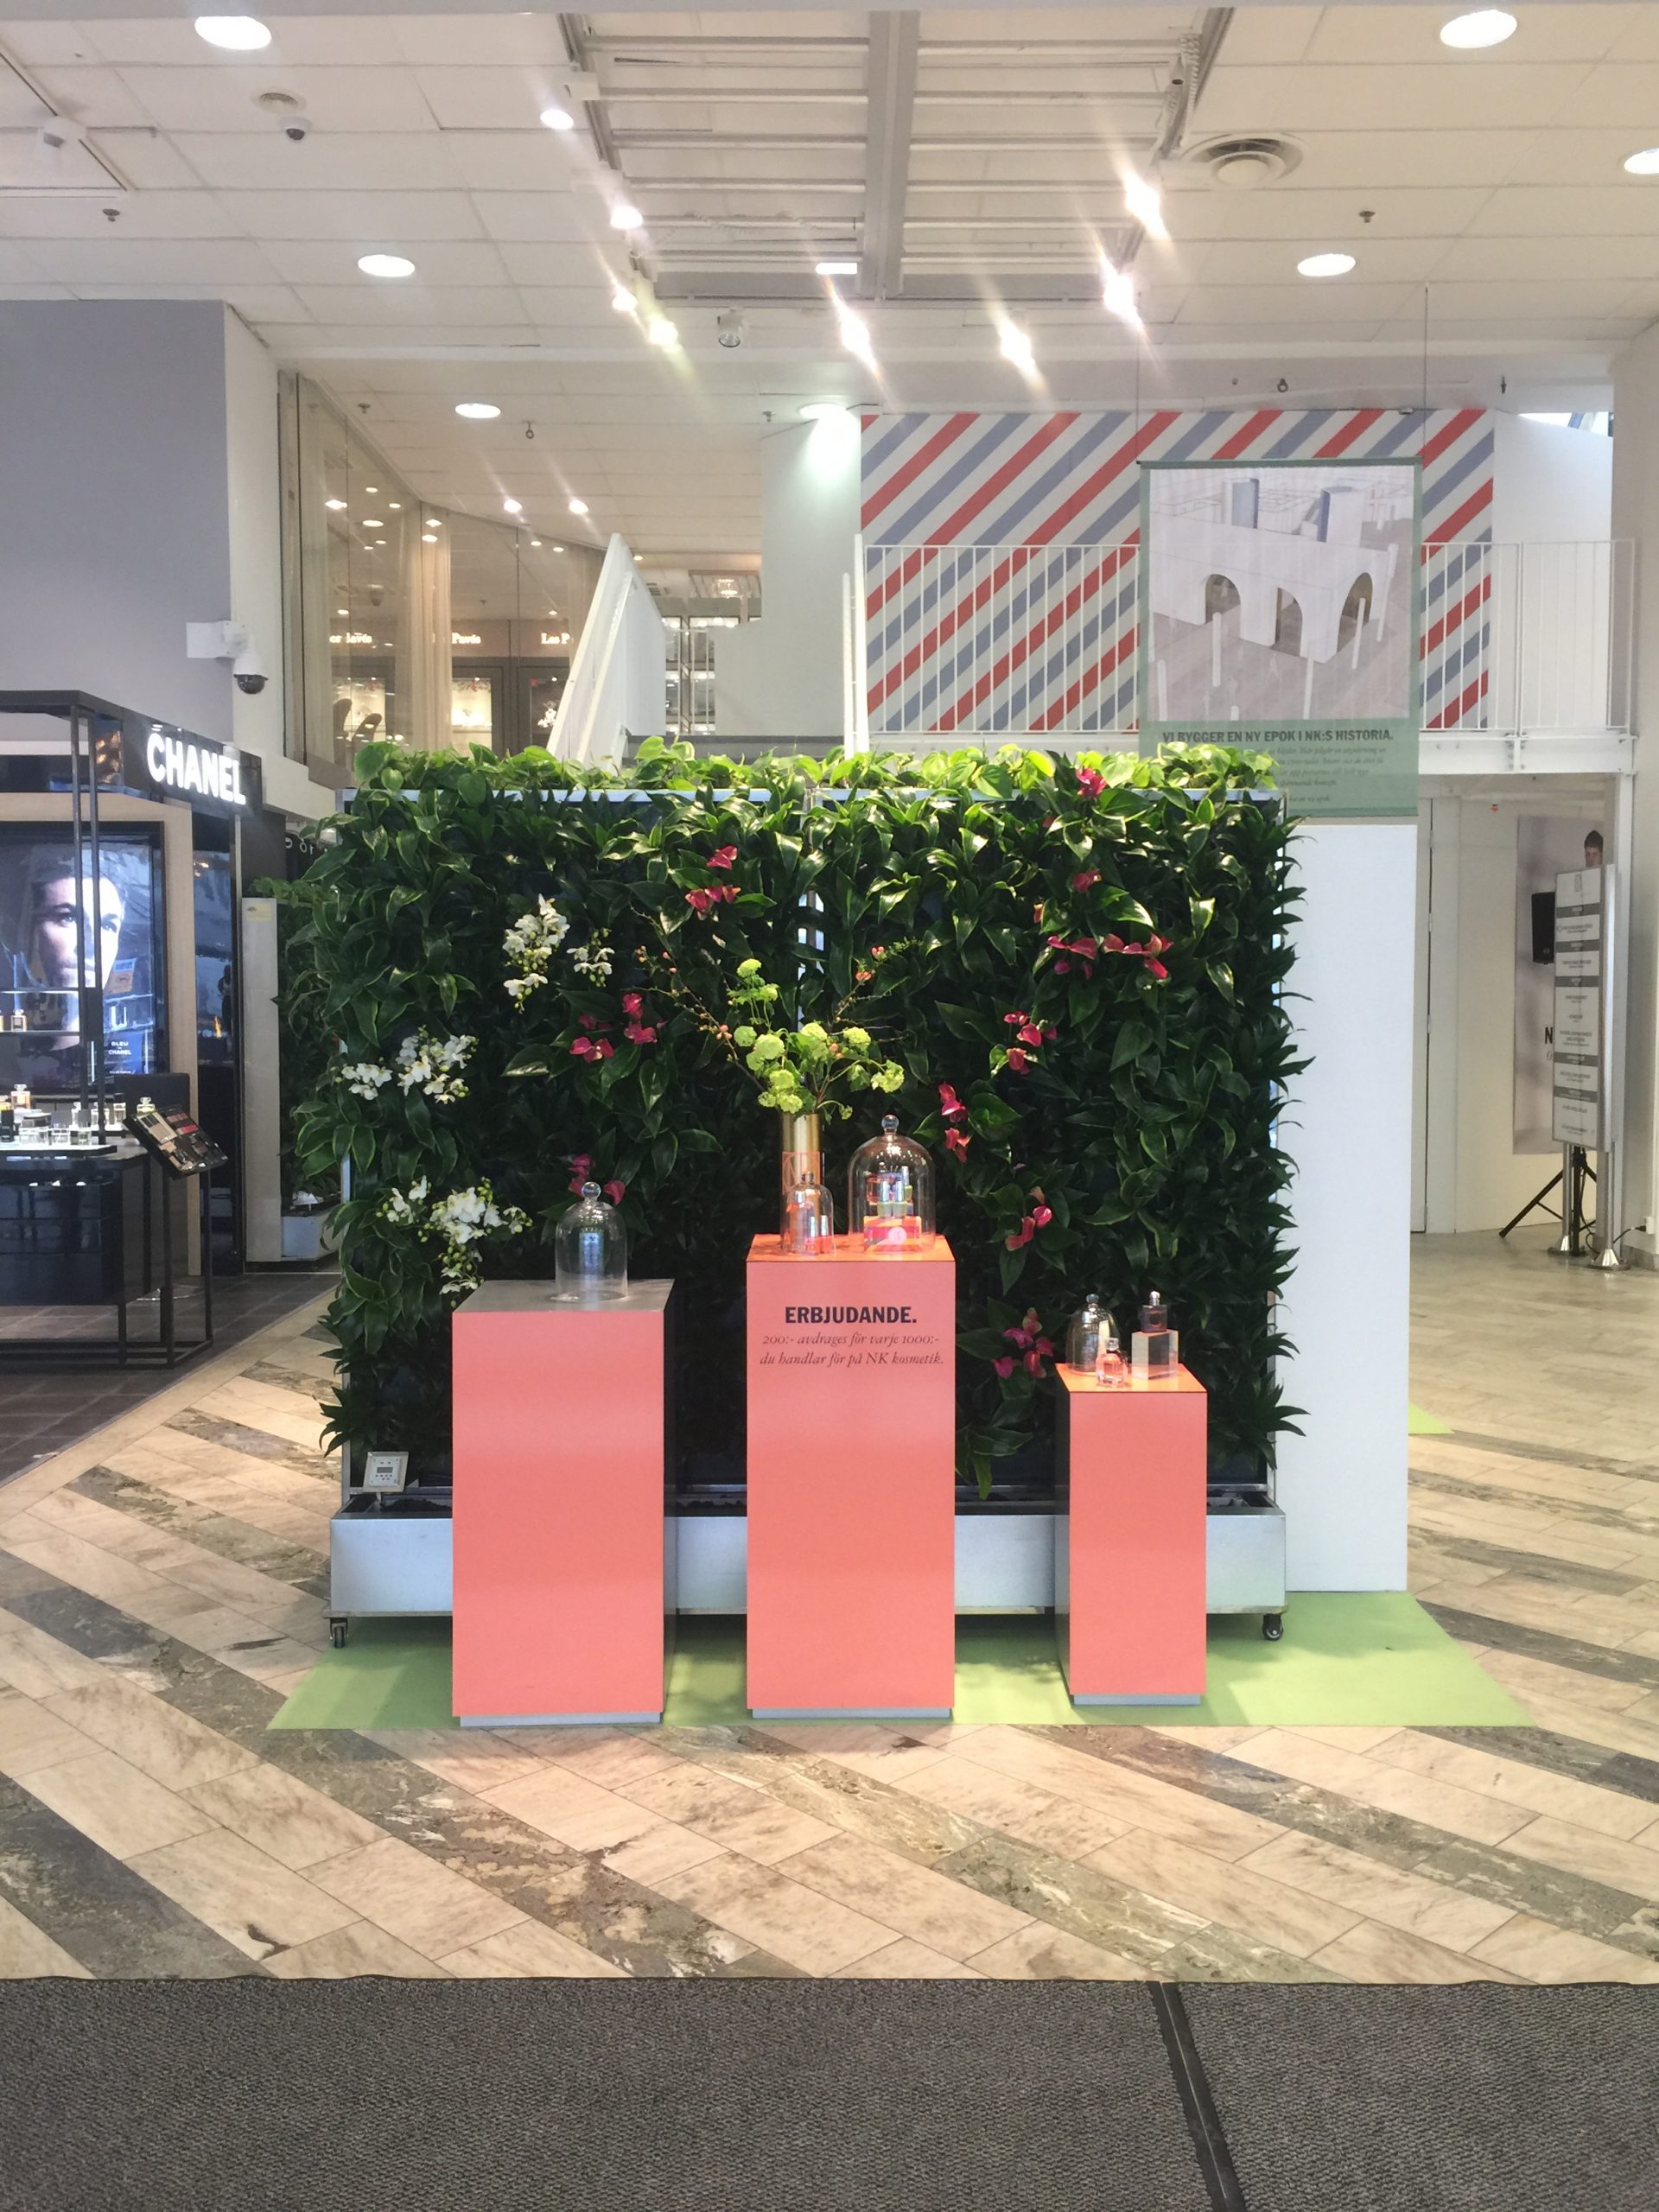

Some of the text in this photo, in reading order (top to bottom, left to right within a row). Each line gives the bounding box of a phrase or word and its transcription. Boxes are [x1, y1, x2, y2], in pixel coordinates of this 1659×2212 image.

[1162, 729, 1394, 742] VI BYGGER EN NY EPOK I NK:S HISTORIA.
[146, 732, 247, 805] CHANEL
[785, 1306, 918, 1324] ERBJUDANDE.
[762, 1332, 940, 1348] 200:- avdrages för varje 1000:-
[760, 1351, 944, 1368] du handlar för på NK kosmetik.
